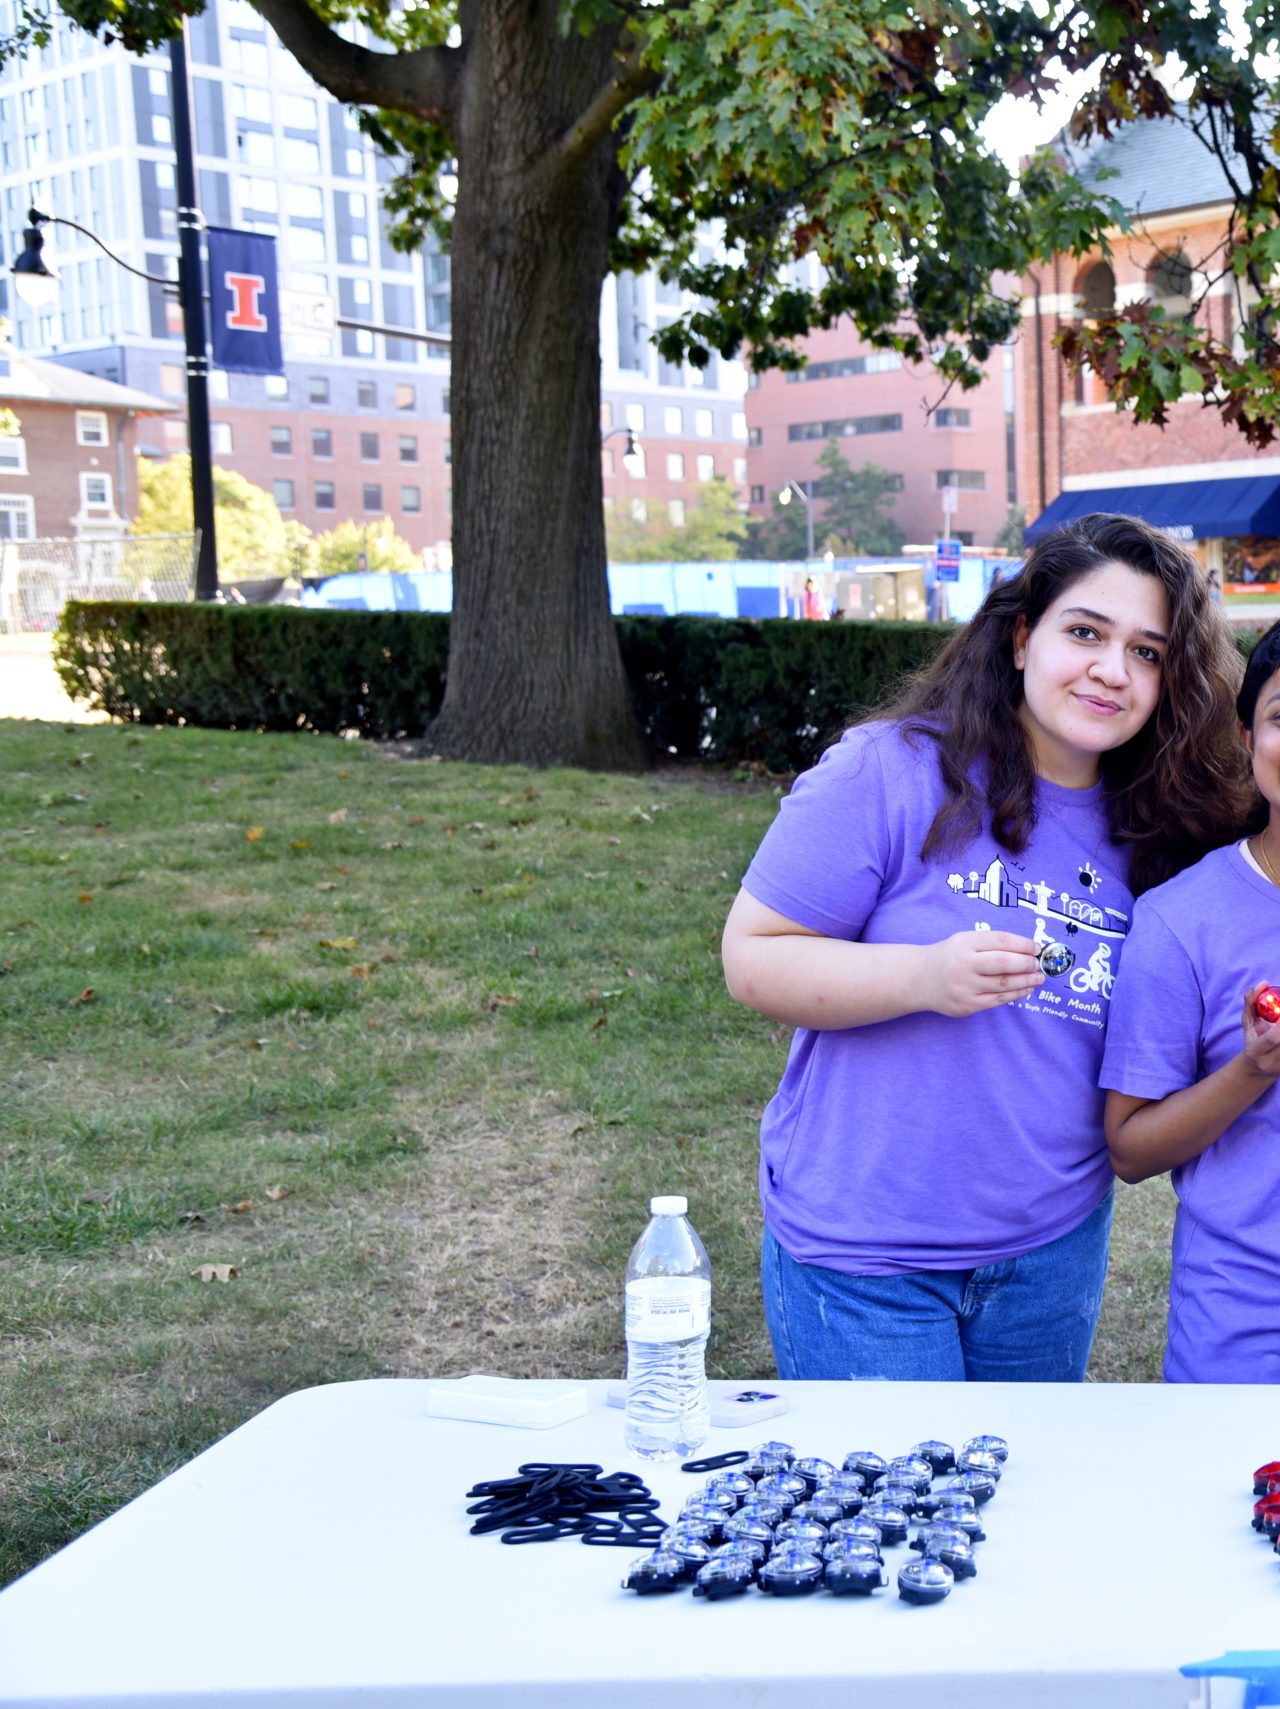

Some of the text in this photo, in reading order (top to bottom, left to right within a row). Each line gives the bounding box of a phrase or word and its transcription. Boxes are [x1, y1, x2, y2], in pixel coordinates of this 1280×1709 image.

[224, 271, 267, 332] I
[1038, 990, 1062, 1005] Bike
[1067, 998, 1101, 1015] Month
